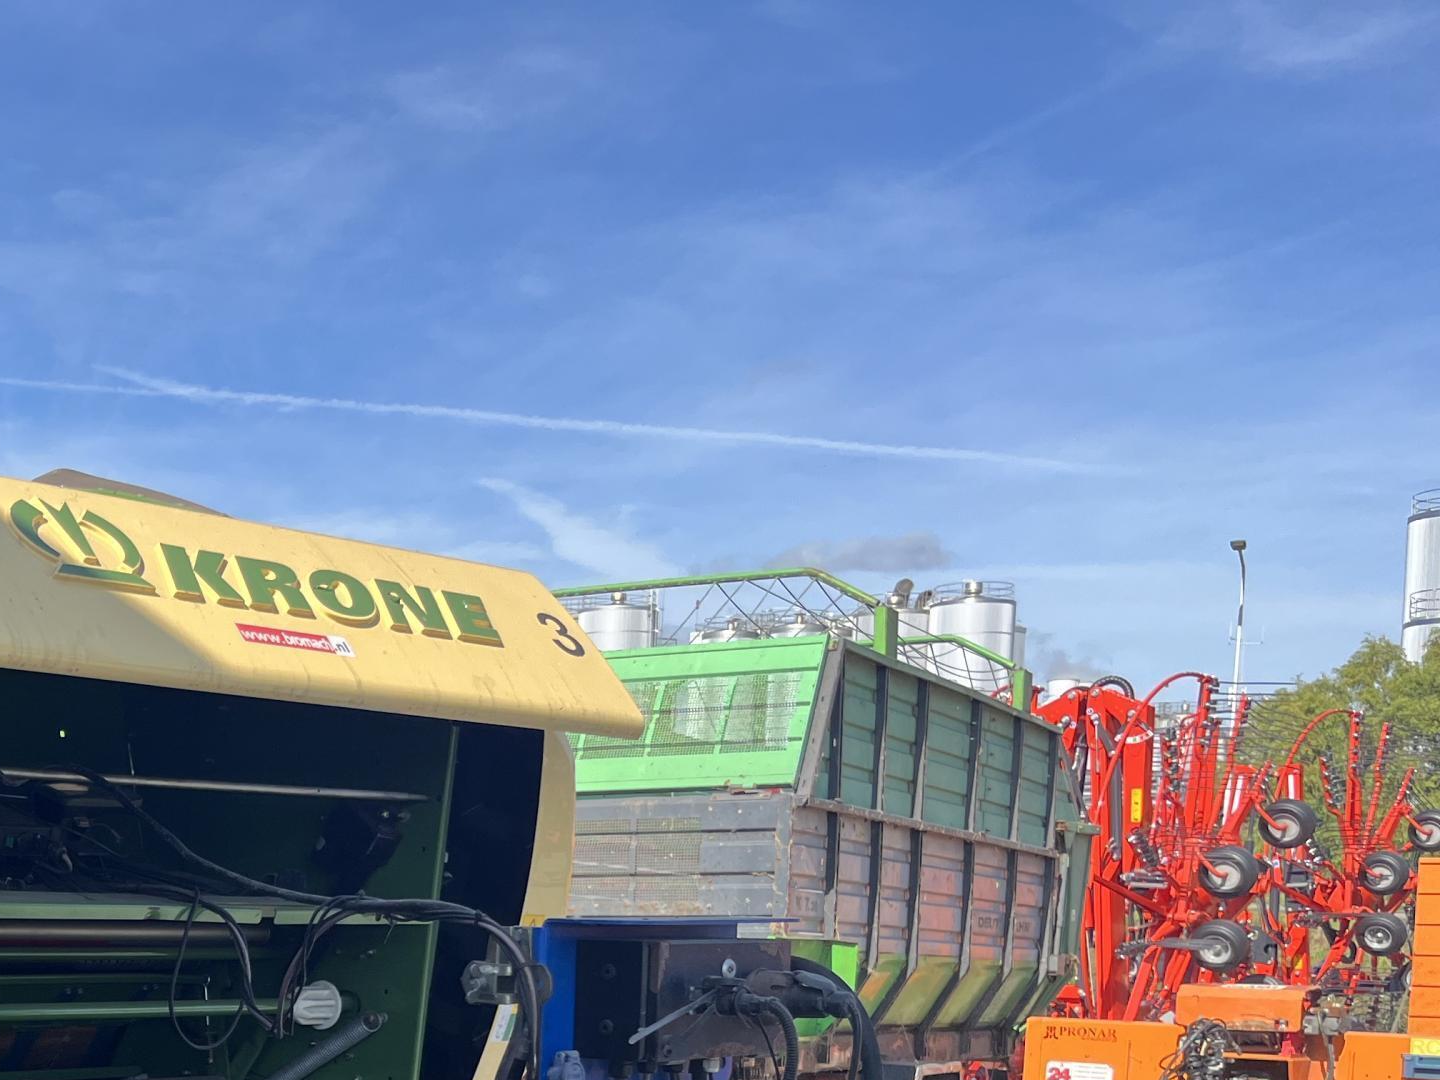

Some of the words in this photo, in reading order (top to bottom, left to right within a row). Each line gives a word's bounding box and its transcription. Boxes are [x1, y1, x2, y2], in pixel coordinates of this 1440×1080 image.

[160, 543, 504, 648] KRONE
[240, 629, 350, 653] www.bromach.nl
[536, 612, 586, 658] 3
[1060, 1026, 1118, 1040] PRONAR
